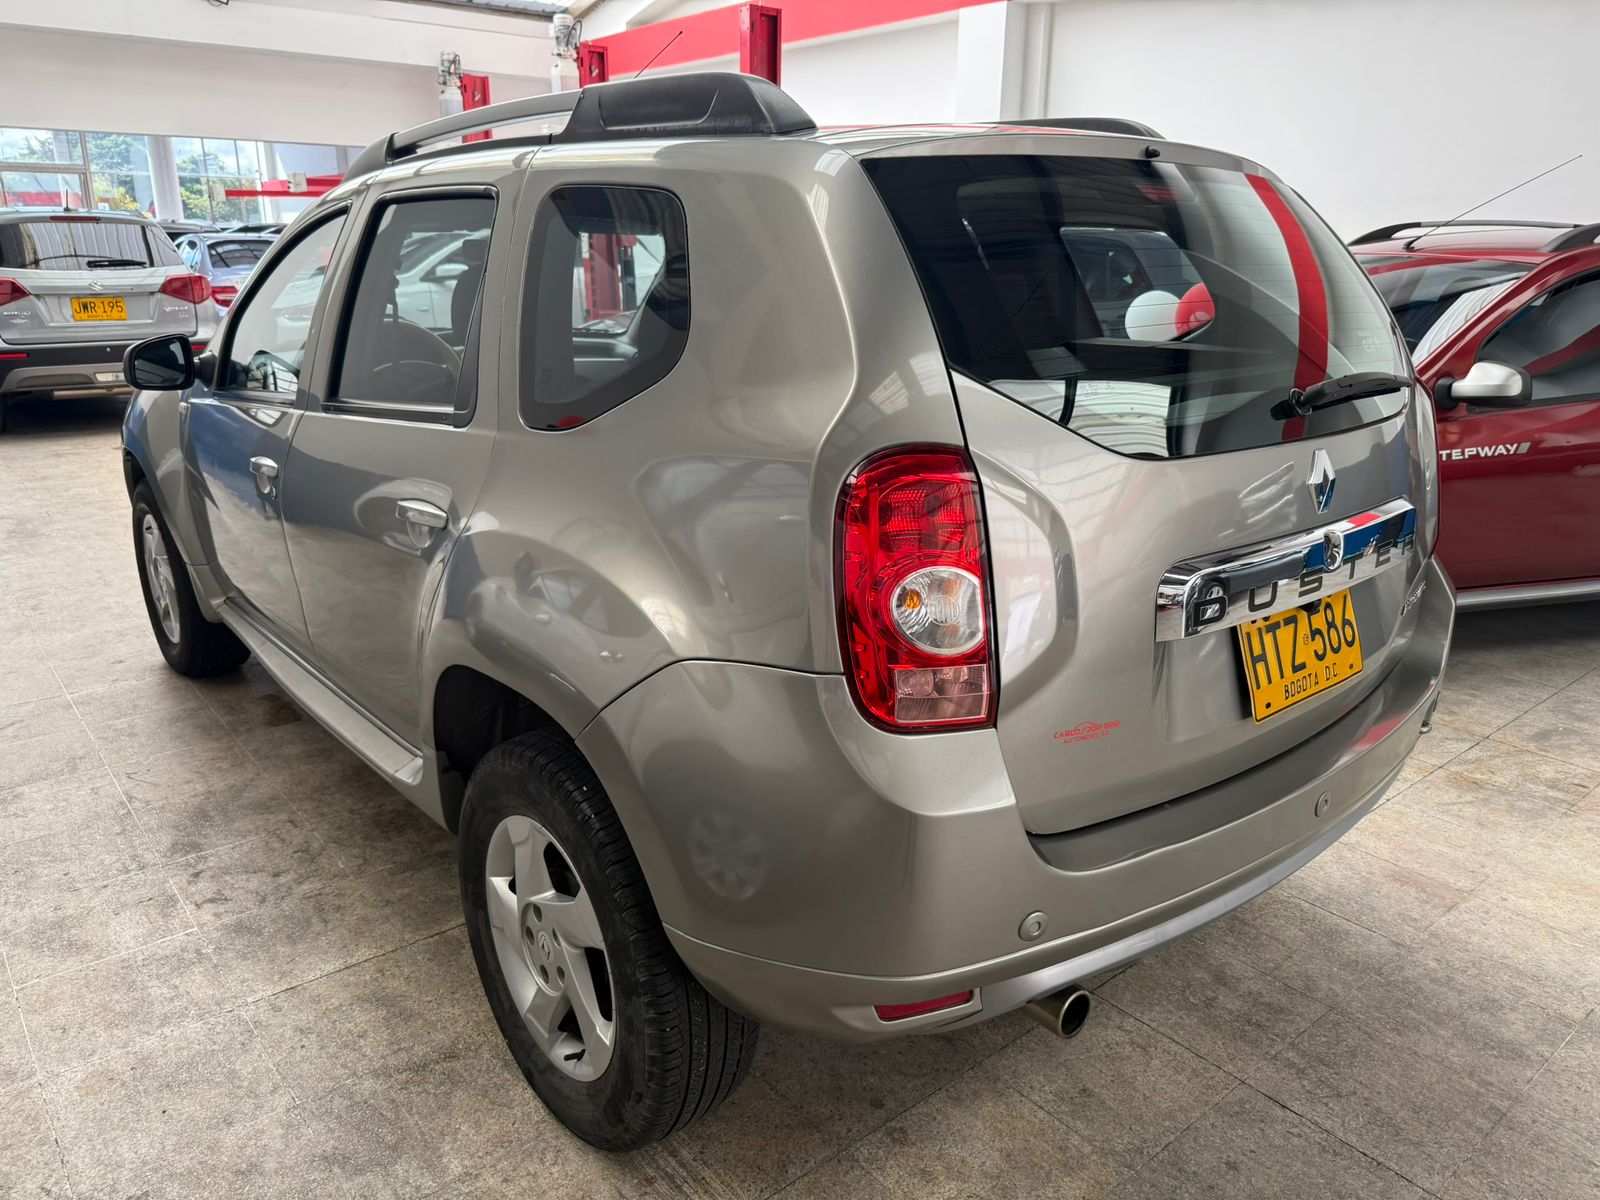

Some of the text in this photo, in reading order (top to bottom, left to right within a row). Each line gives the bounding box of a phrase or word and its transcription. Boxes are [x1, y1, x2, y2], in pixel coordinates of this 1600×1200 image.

[74, 301, 124, 314] JWR 195
[1439, 443, 1518, 461] TEPWAY
[1192, 533, 1417, 629] DUSTER
[1245, 613, 1307, 690] HTZ
[1306, 594, 1356, 662] 586
[1284, 670, 1319, 700] BOGOTA
